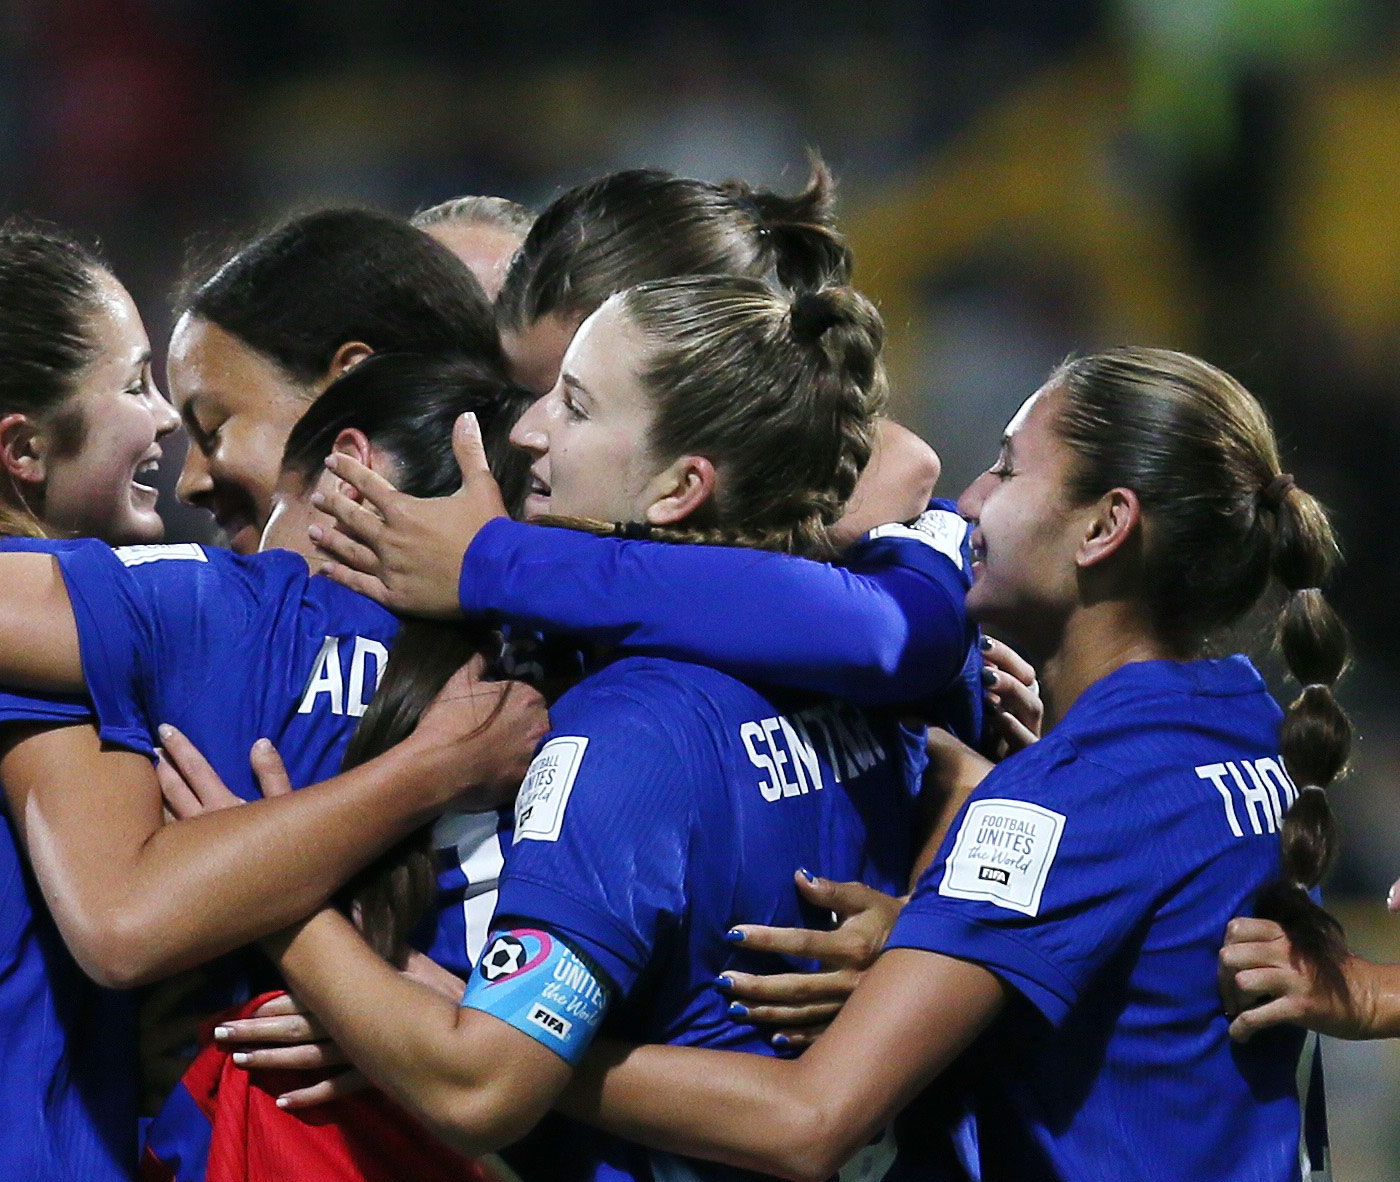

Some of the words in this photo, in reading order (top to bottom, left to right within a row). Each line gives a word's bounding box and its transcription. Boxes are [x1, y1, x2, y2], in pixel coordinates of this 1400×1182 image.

[298, 635, 389, 717] AD
[1194, 755, 1300, 837] THO
[981, 815, 1037, 837] FOOTBALL
[976, 828, 1034, 855] UNITES
[968, 846, 990, 860] the
[991, 848, 1032, 875] World
[981, 868, 1007, 883] FIFA
[541, 982, 567, 1006] the
[534, 1009, 565, 1034] FIFA
